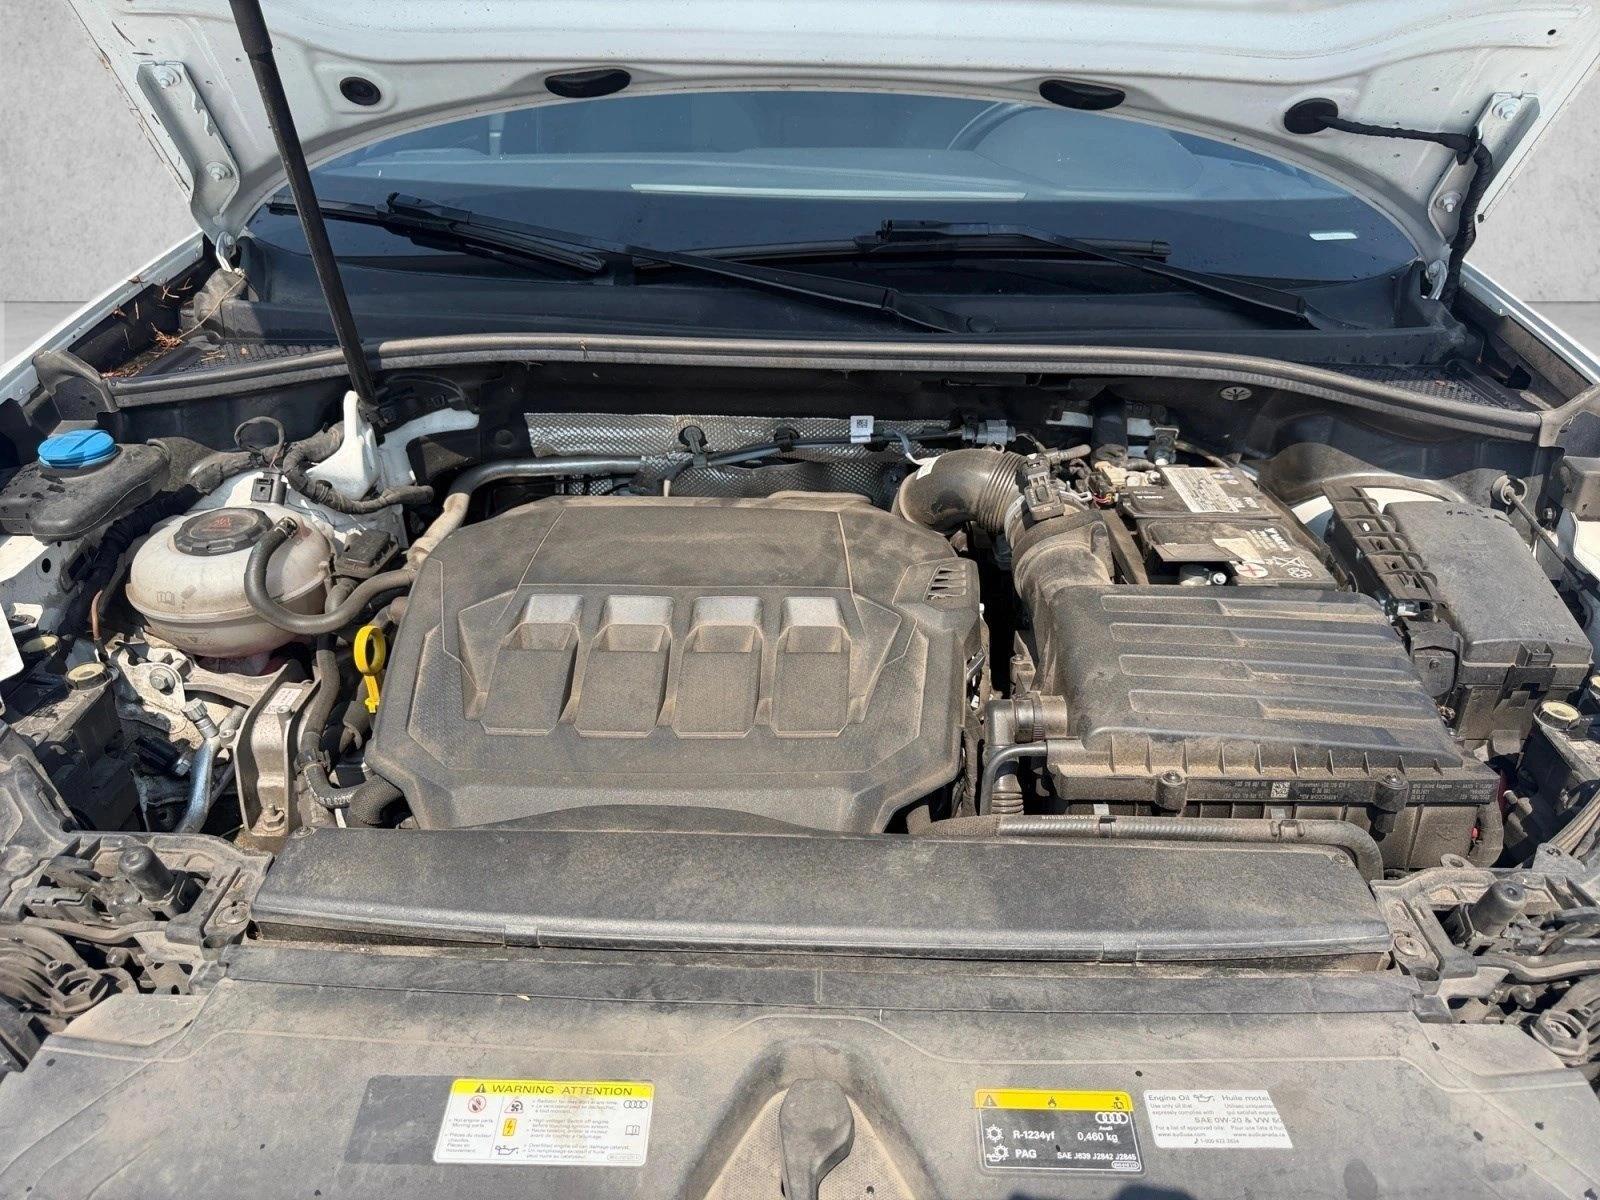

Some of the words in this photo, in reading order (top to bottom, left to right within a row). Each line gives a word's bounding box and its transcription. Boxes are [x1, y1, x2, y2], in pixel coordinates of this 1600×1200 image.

[492, 1085, 554, 1094] WARNING
[562, 1086, 632, 1096] ATTENTION
[1013, 1130, 1056, 1141] R-1234yf
[1077, 1132, 1104, 1142] 0,460
[1106, 1132, 1118, 1143] kg
[1015, 1149, 1037, 1158] PAG
